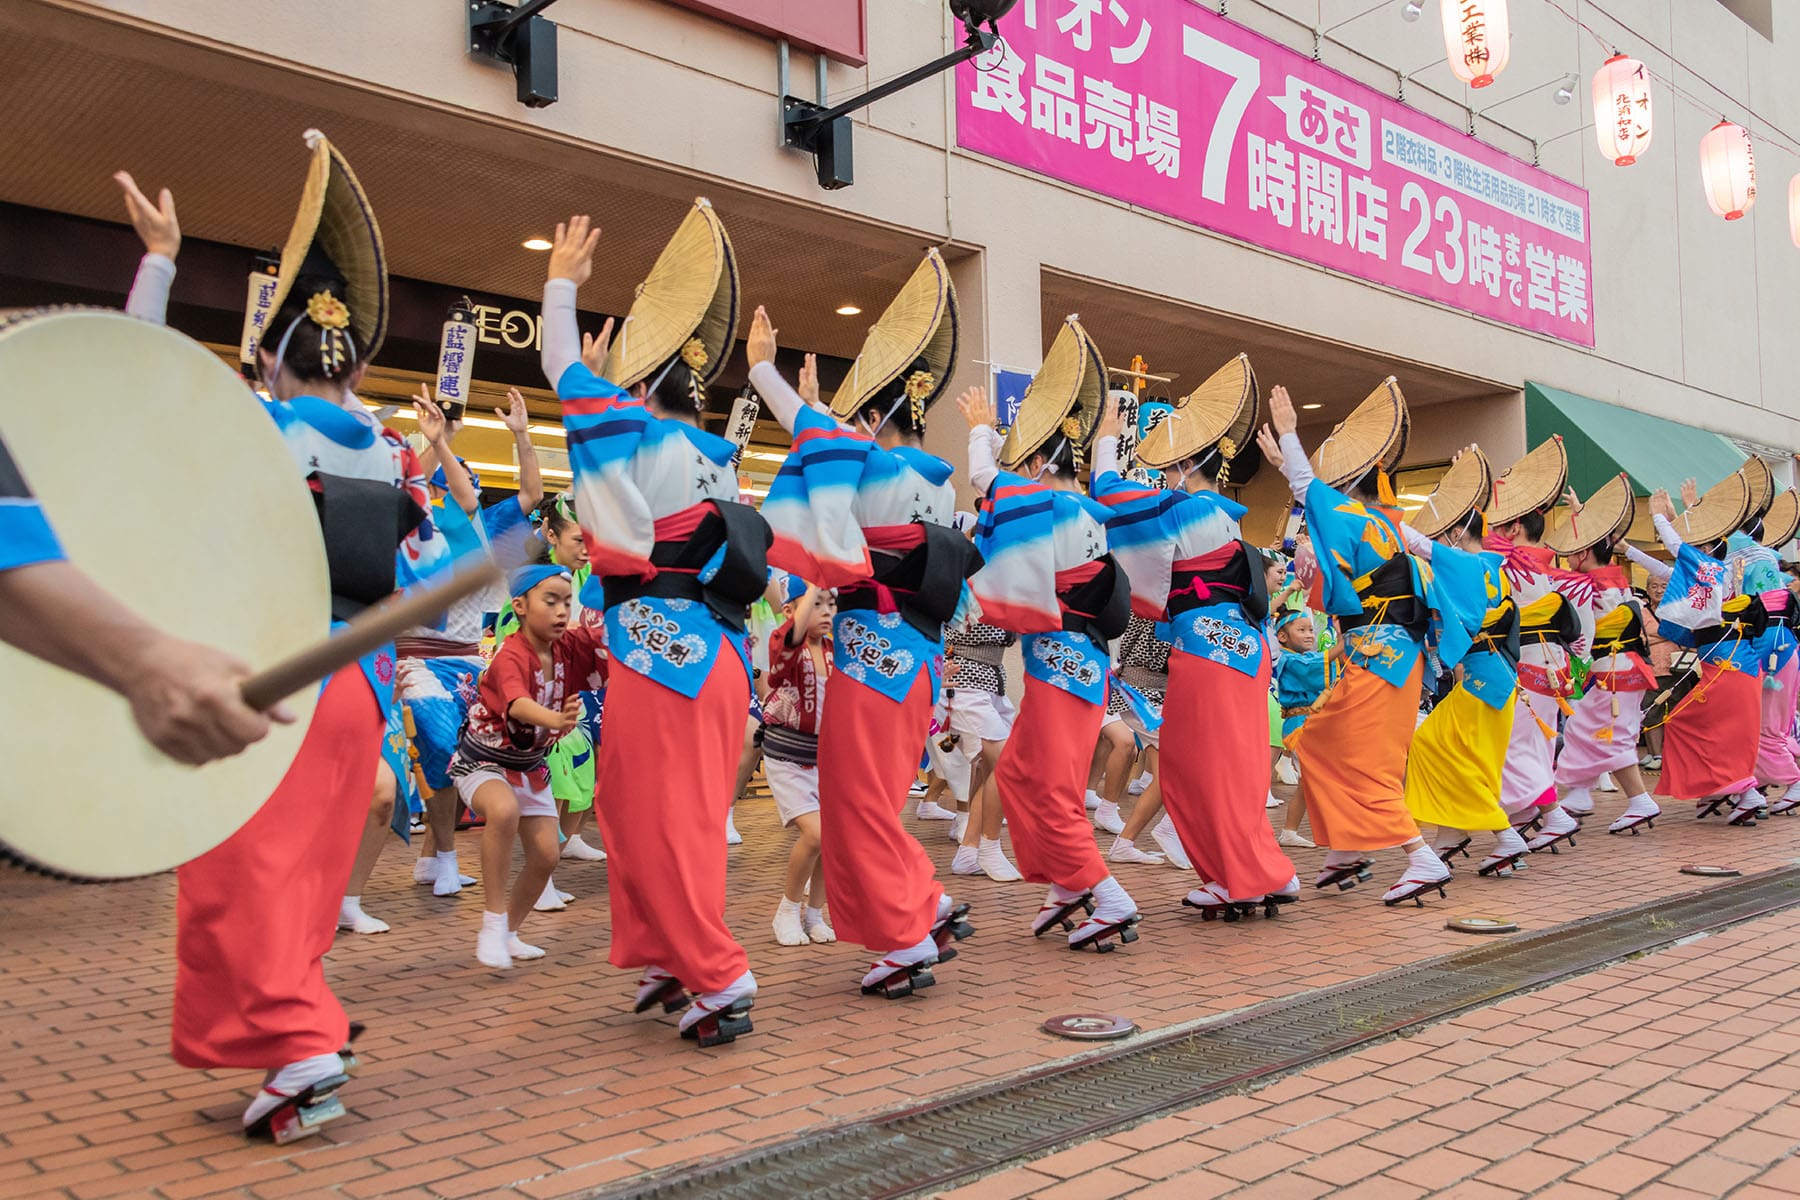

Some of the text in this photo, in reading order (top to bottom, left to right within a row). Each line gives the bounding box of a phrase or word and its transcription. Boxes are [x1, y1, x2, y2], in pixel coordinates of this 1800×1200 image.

[970, 35, 1181, 179] 食品売場
[1400, 181, 1588, 325] 23時まで営業
[1300, 88, 1360, 160] あさ
